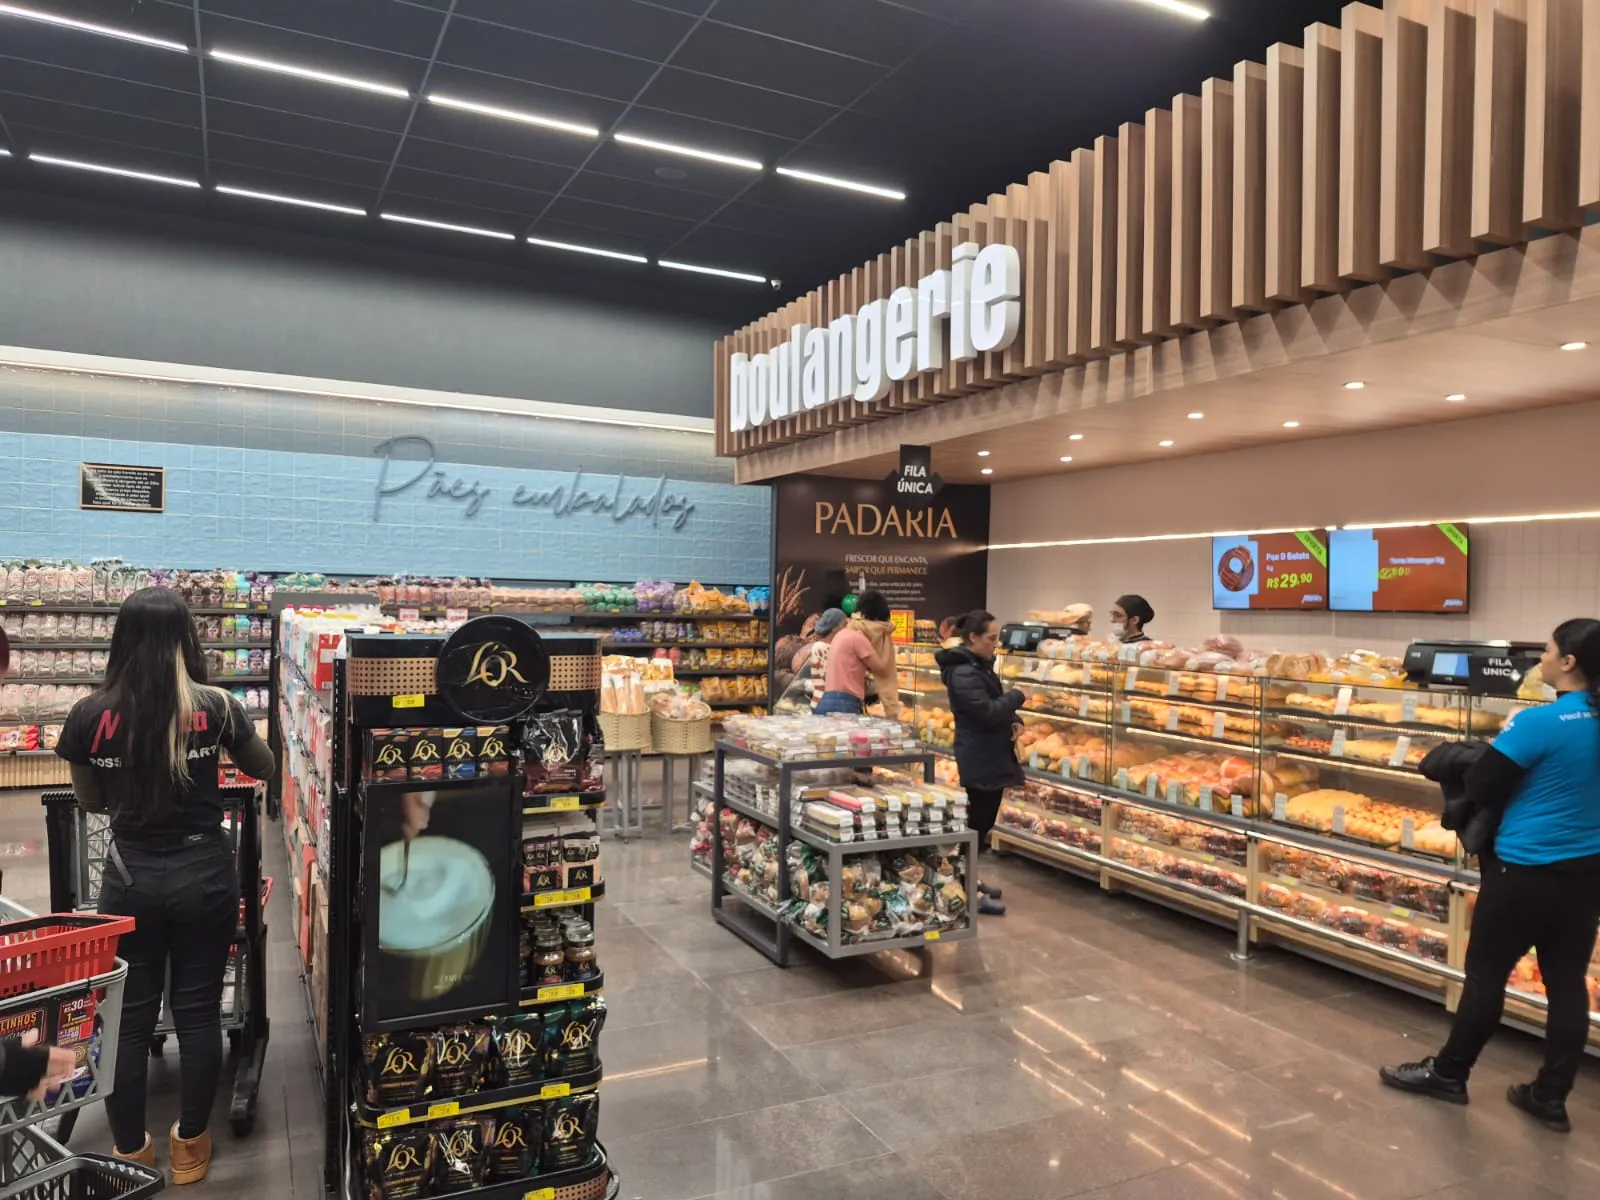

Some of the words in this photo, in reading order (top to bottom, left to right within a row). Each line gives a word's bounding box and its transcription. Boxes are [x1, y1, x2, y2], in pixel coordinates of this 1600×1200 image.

[731, 242, 1020, 432] boulangerie
[904, 465, 926, 477] FILA
[373, 435, 490, 522] Pães
[513, 465, 695, 529] embalados
[897, 478, 933, 494] ÚNICA
[815, 501, 957, 538] PADARIA
[879, 555, 893, 564] QUE
[460, 641, 529, 687] L'OR
[1488, 657, 1512, 667] FILA
[184, 744, 217, 760] AR?
[90, 757, 121, 768] POSS
